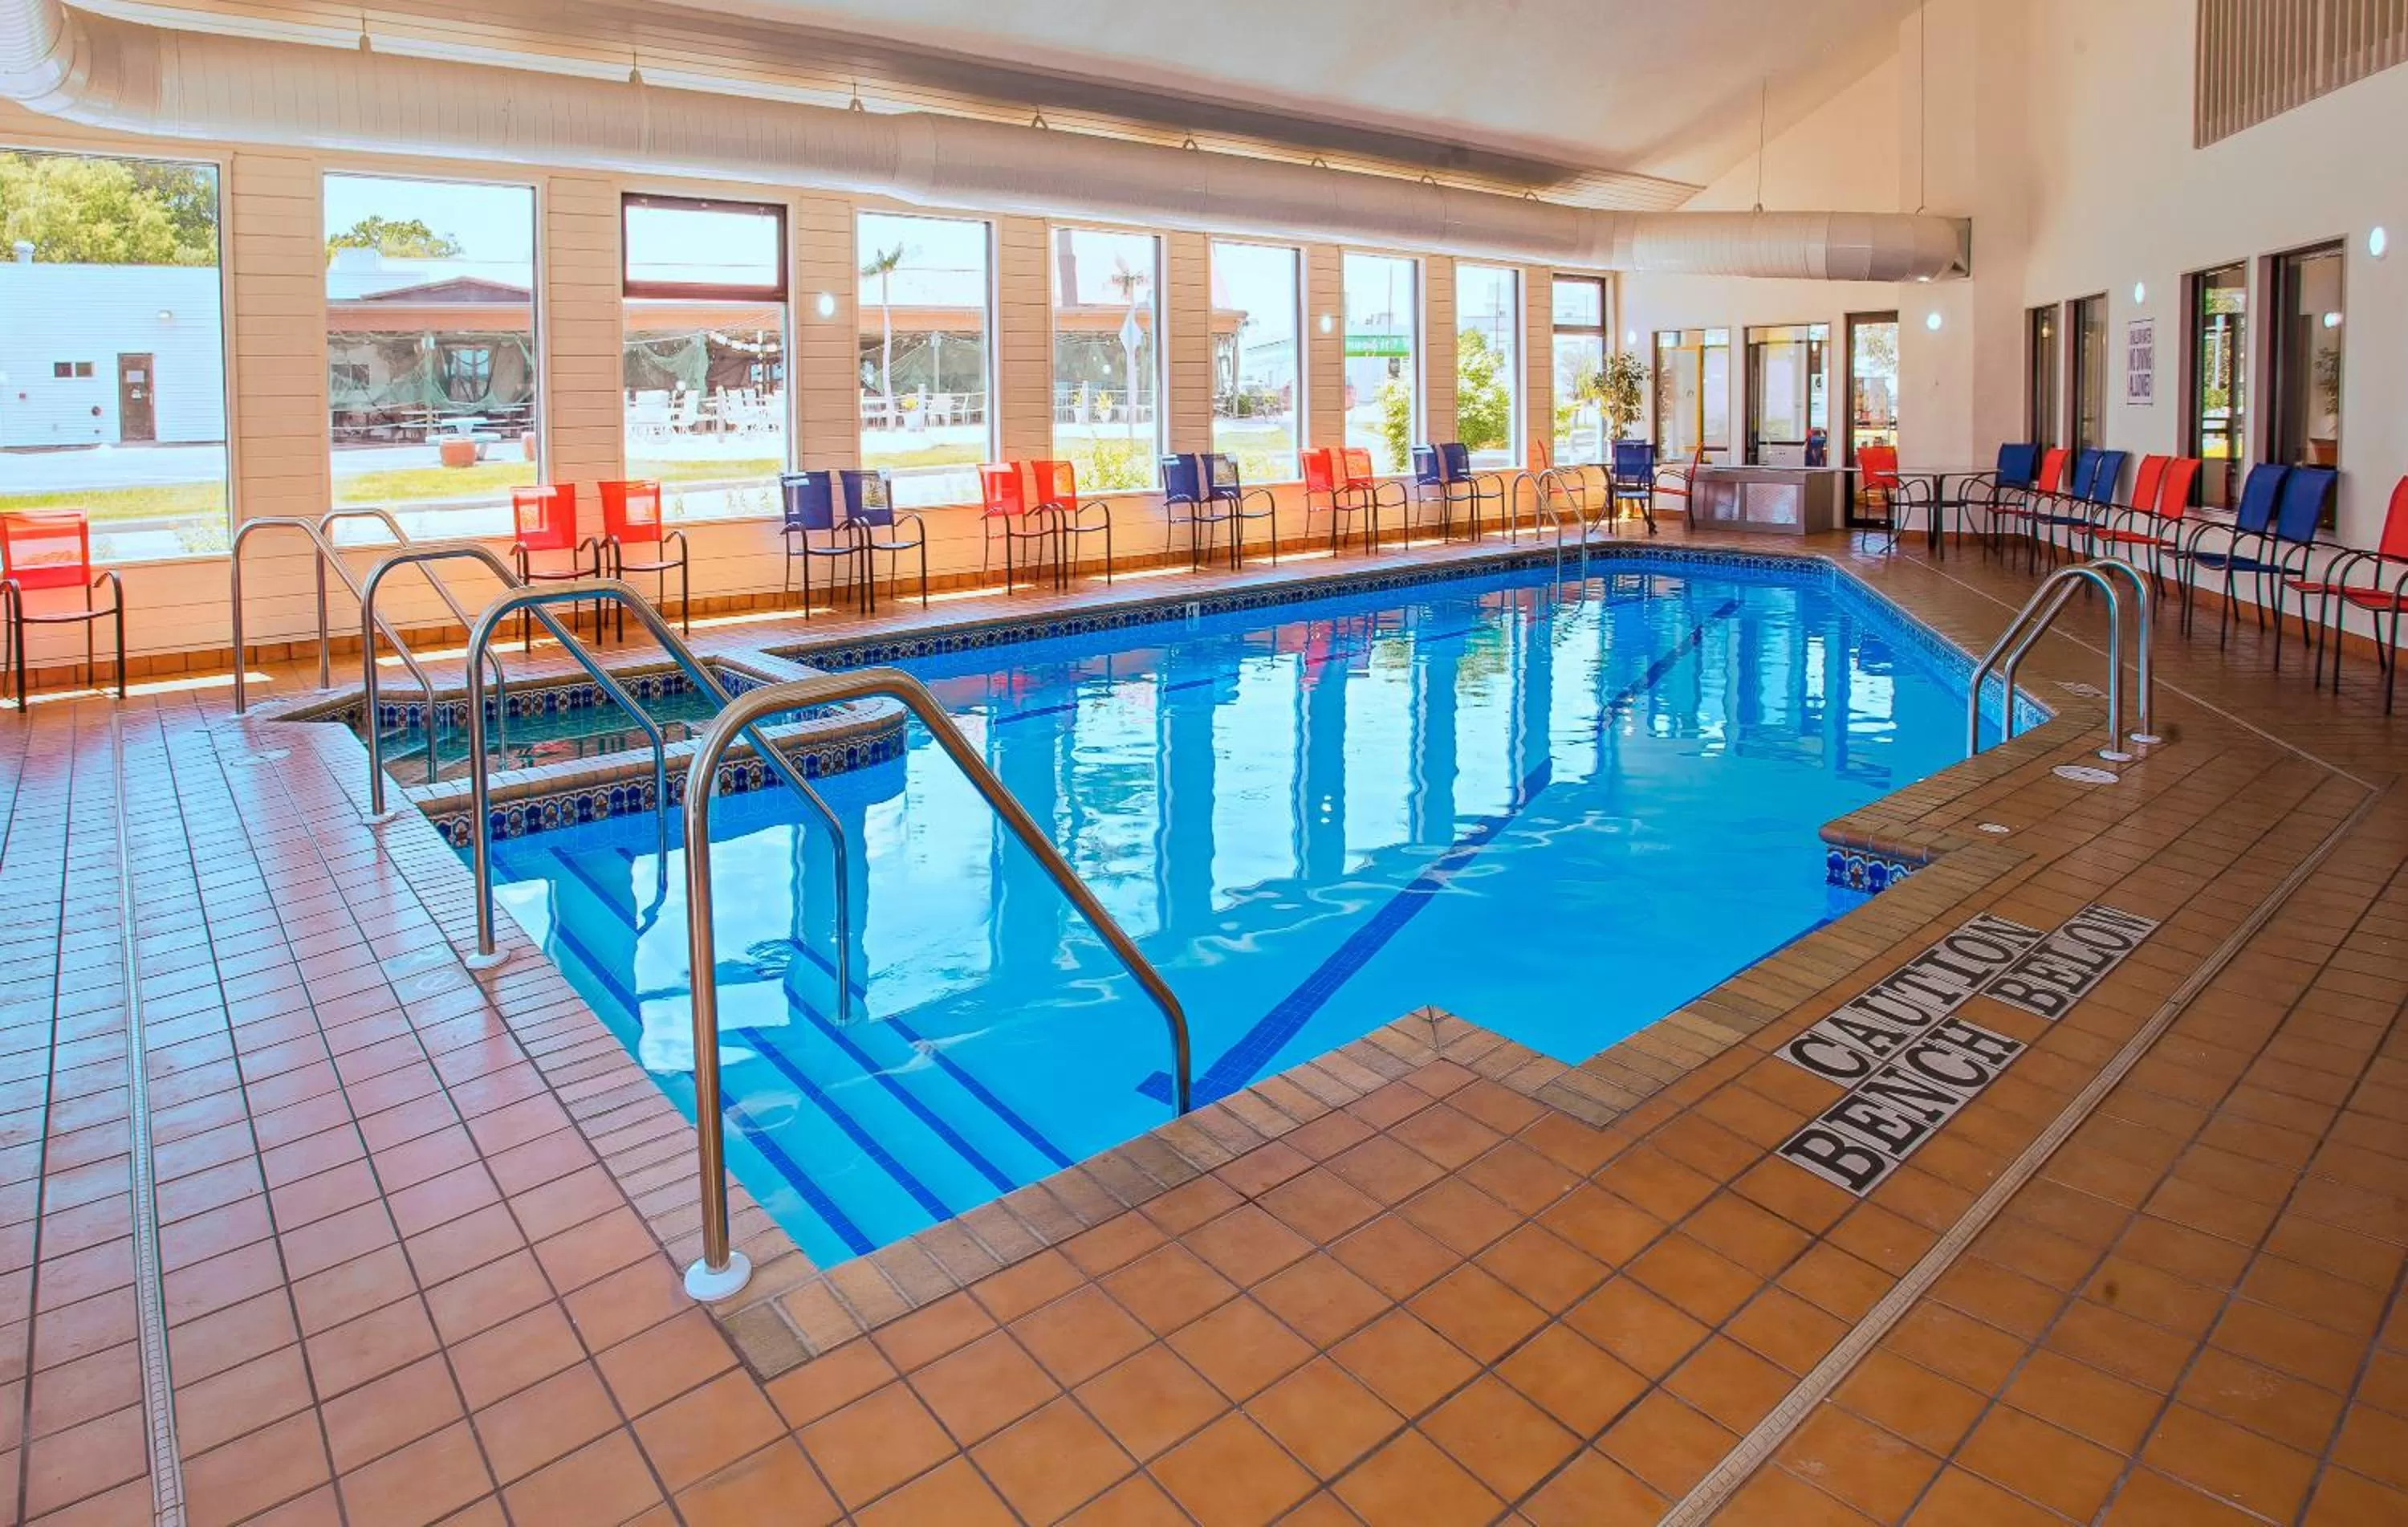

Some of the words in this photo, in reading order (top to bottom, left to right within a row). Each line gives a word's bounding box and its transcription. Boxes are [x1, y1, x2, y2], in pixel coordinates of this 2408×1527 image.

[1784, 1018, 2024, 1191] BENCH
[1990, 903, 2157, 1018] BELOW
[1789, 914, 2045, 1081] CAUTION
